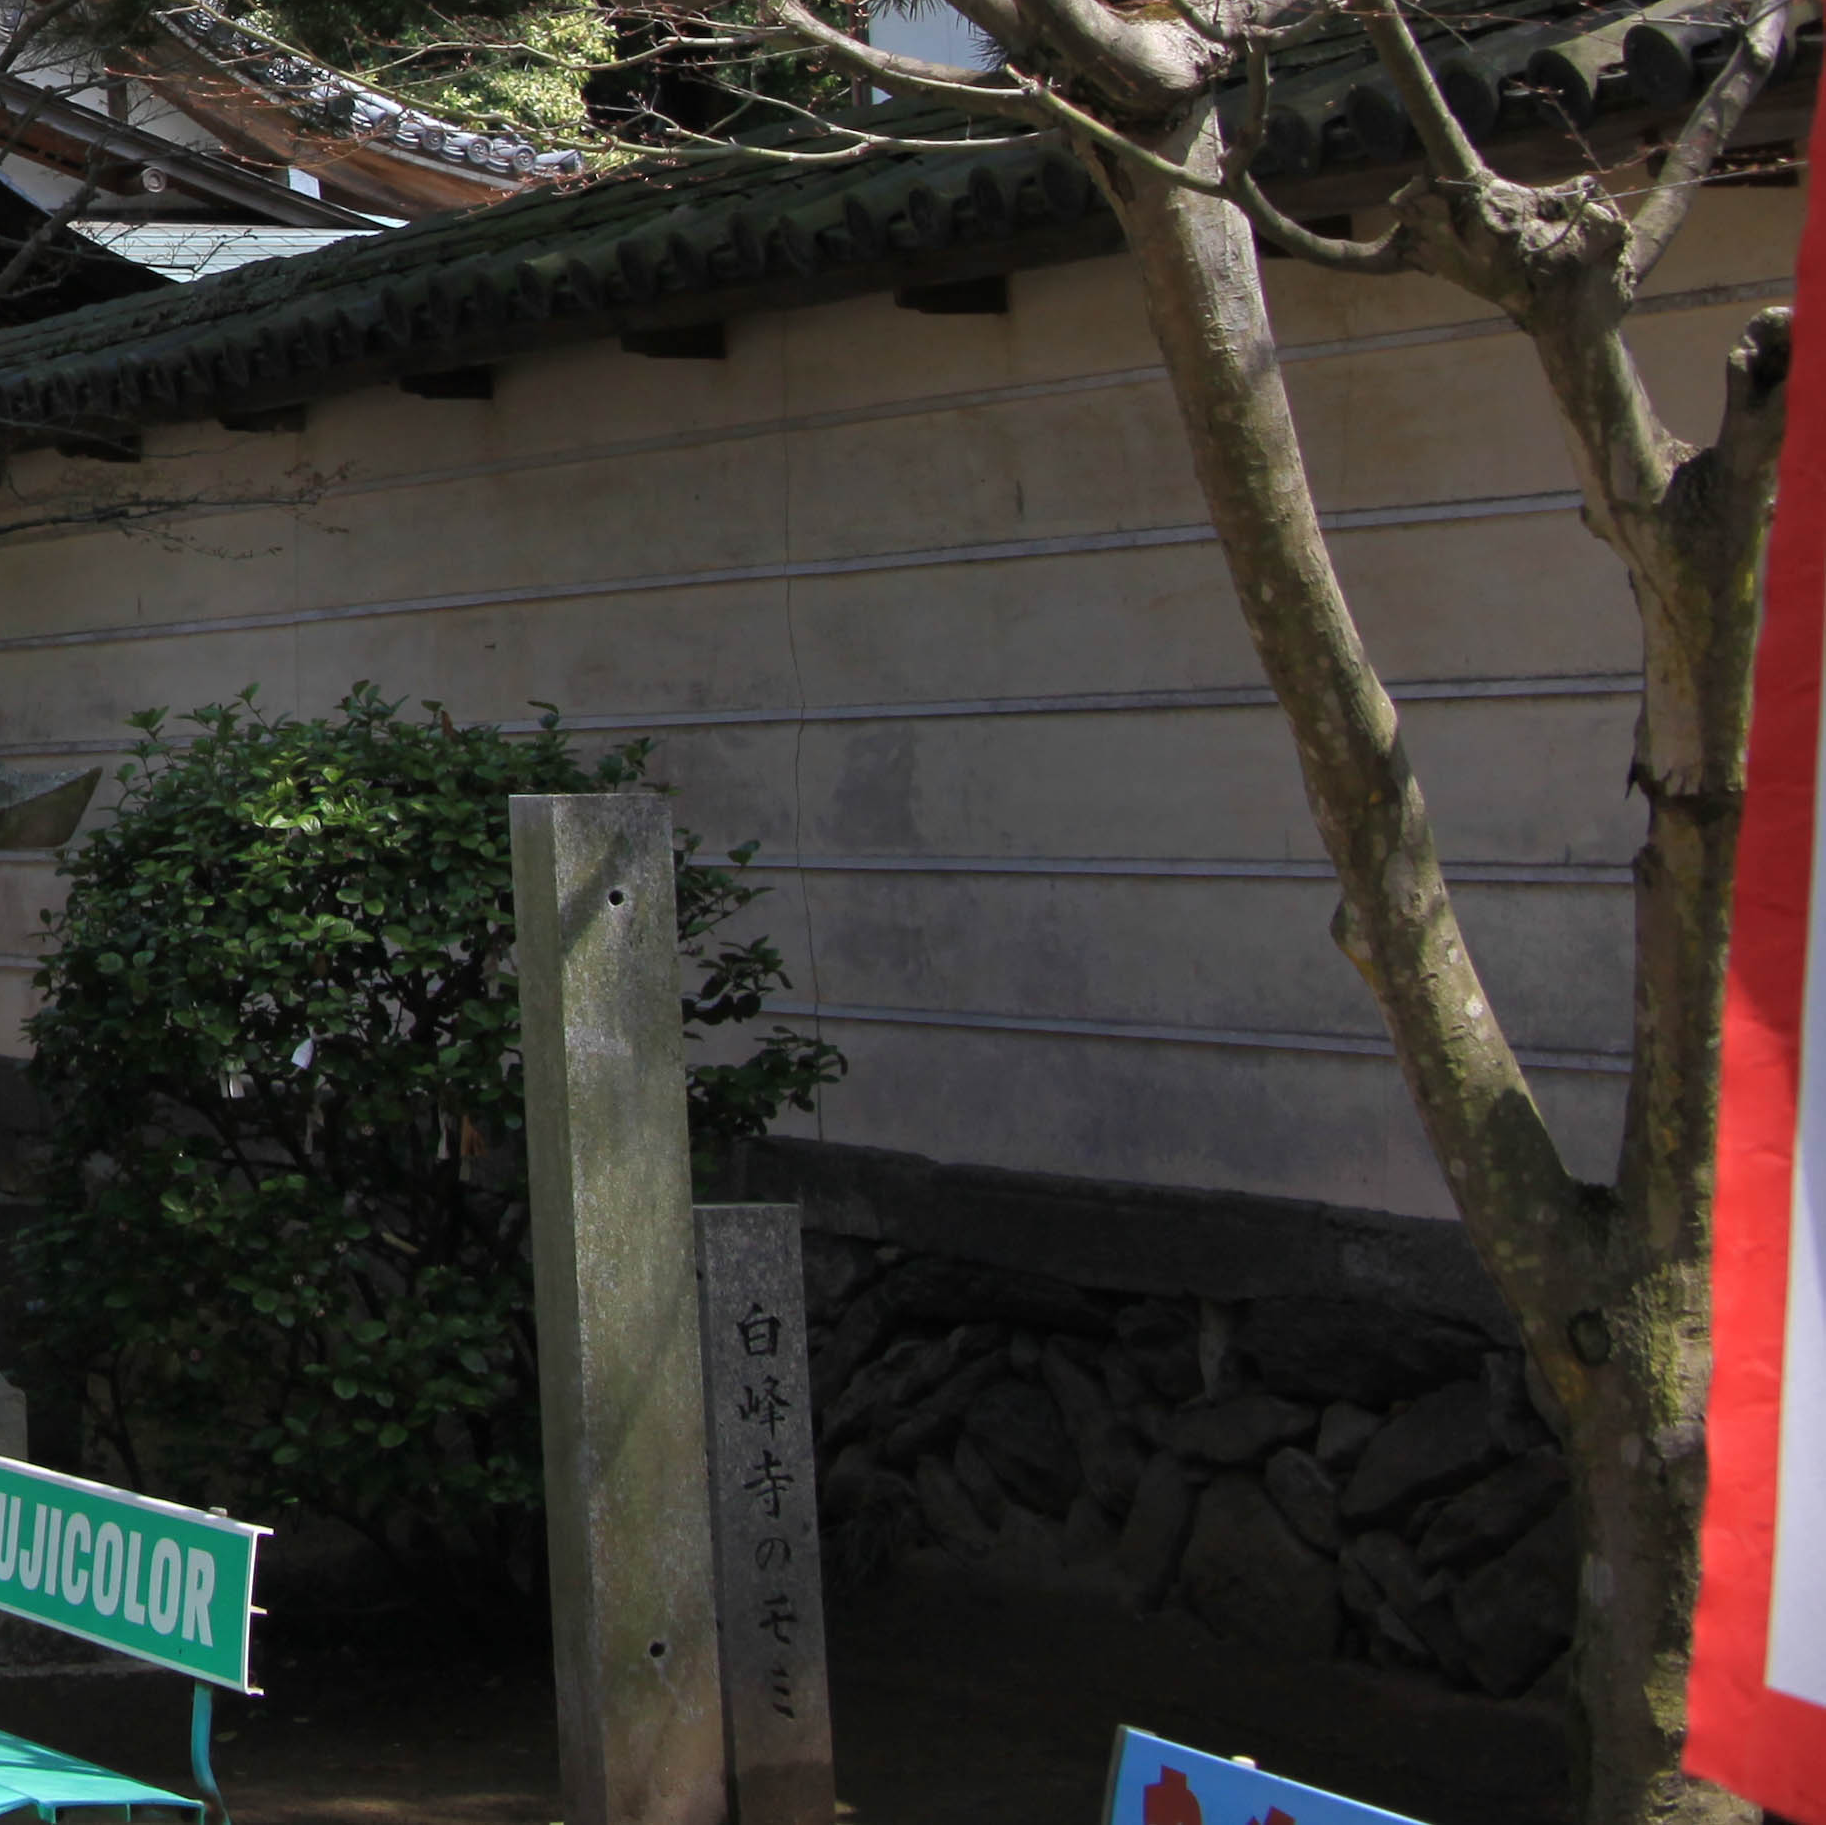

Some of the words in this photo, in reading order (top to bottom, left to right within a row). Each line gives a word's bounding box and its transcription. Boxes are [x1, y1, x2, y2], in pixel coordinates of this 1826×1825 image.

[735, 1301, 798, 1720] 白峰寺のモミ
